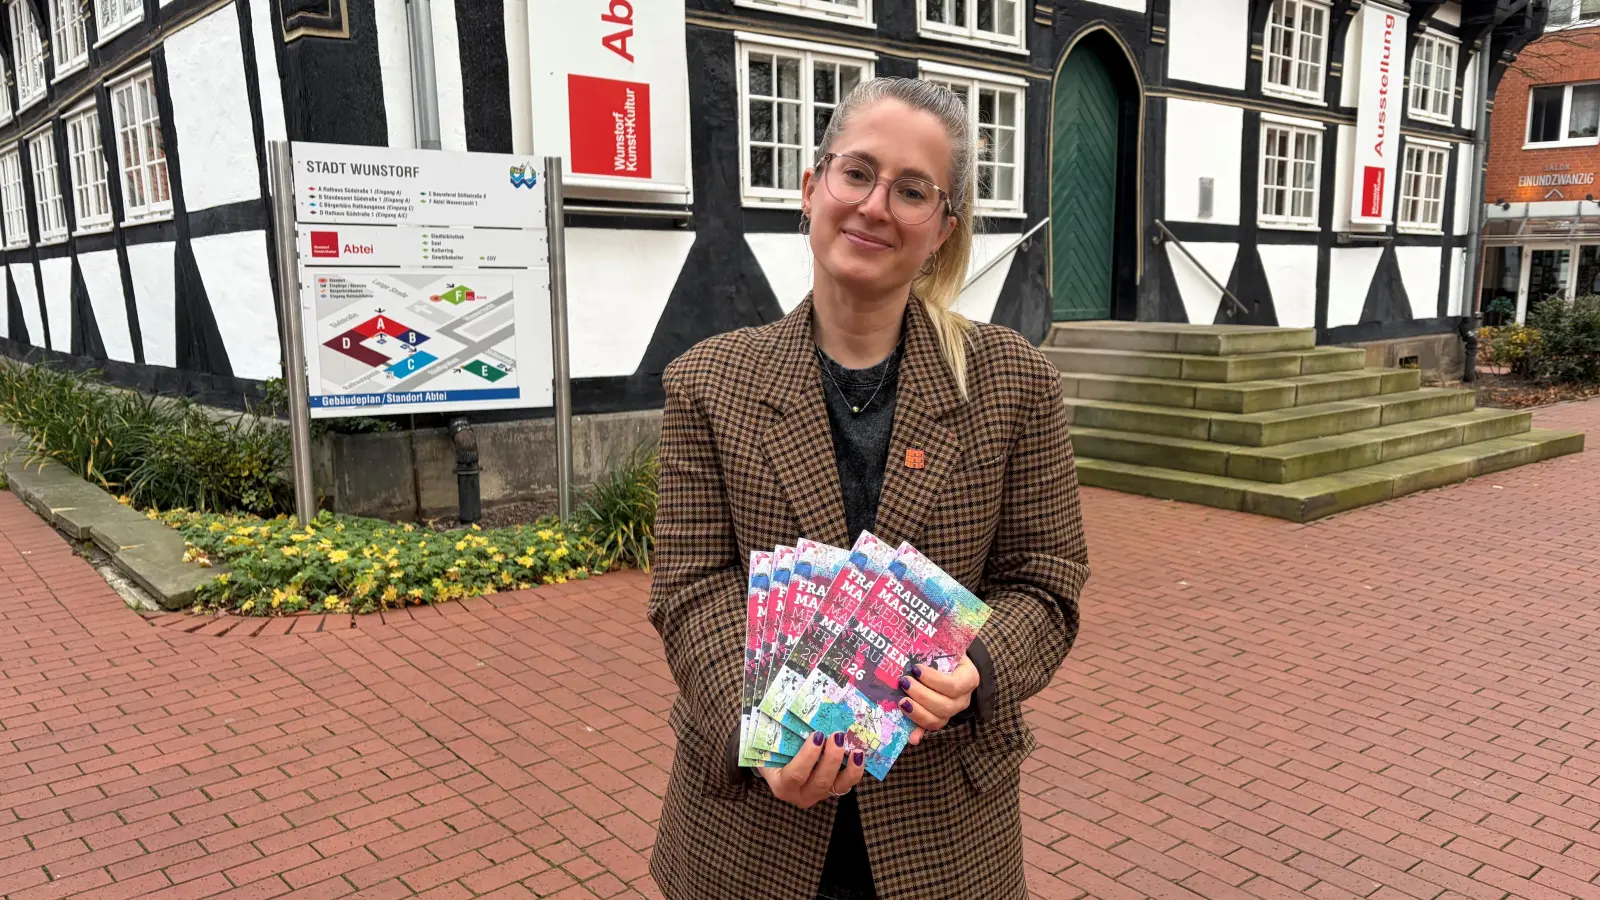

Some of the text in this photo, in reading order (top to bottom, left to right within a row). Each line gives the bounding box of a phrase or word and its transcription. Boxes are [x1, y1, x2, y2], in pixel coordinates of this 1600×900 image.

[1374, 14, 1395, 158] Ausstellung
[624, 88, 637, 172] Kunst+Kultur
[612, 111, 625, 171] Wunstorf
[306, 160, 419, 178] STADT WUNSTORF
[1544, 163, 1570, 171] SALON
[1518, 173, 1594, 187] EINUNDZWANZIG
[344, 244, 373, 254] Abtei
[456, 290, 462, 302] F
[377, 318, 385, 330] A
[342, 337, 350, 349] D
[409, 332, 416, 343] B
[407, 359, 415, 370] C
[481, 365, 488, 376] E
[322, 395, 381, 406] Gebäudeplan
[386, 392, 423, 403] Standort
[425, 391, 447, 401] Abtei
[885, 577, 940, 623] FRAUEN
[870, 600, 922, 642] MEDIEN
[877, 588, 937, 638] MACHEN
[862, 610, 920, 658] MACHEN
[854, 621, 910, 668] MEDIEN
[846, 631, 904, 679] FRAUEN?
[833, 651, 866, 681] 2026
